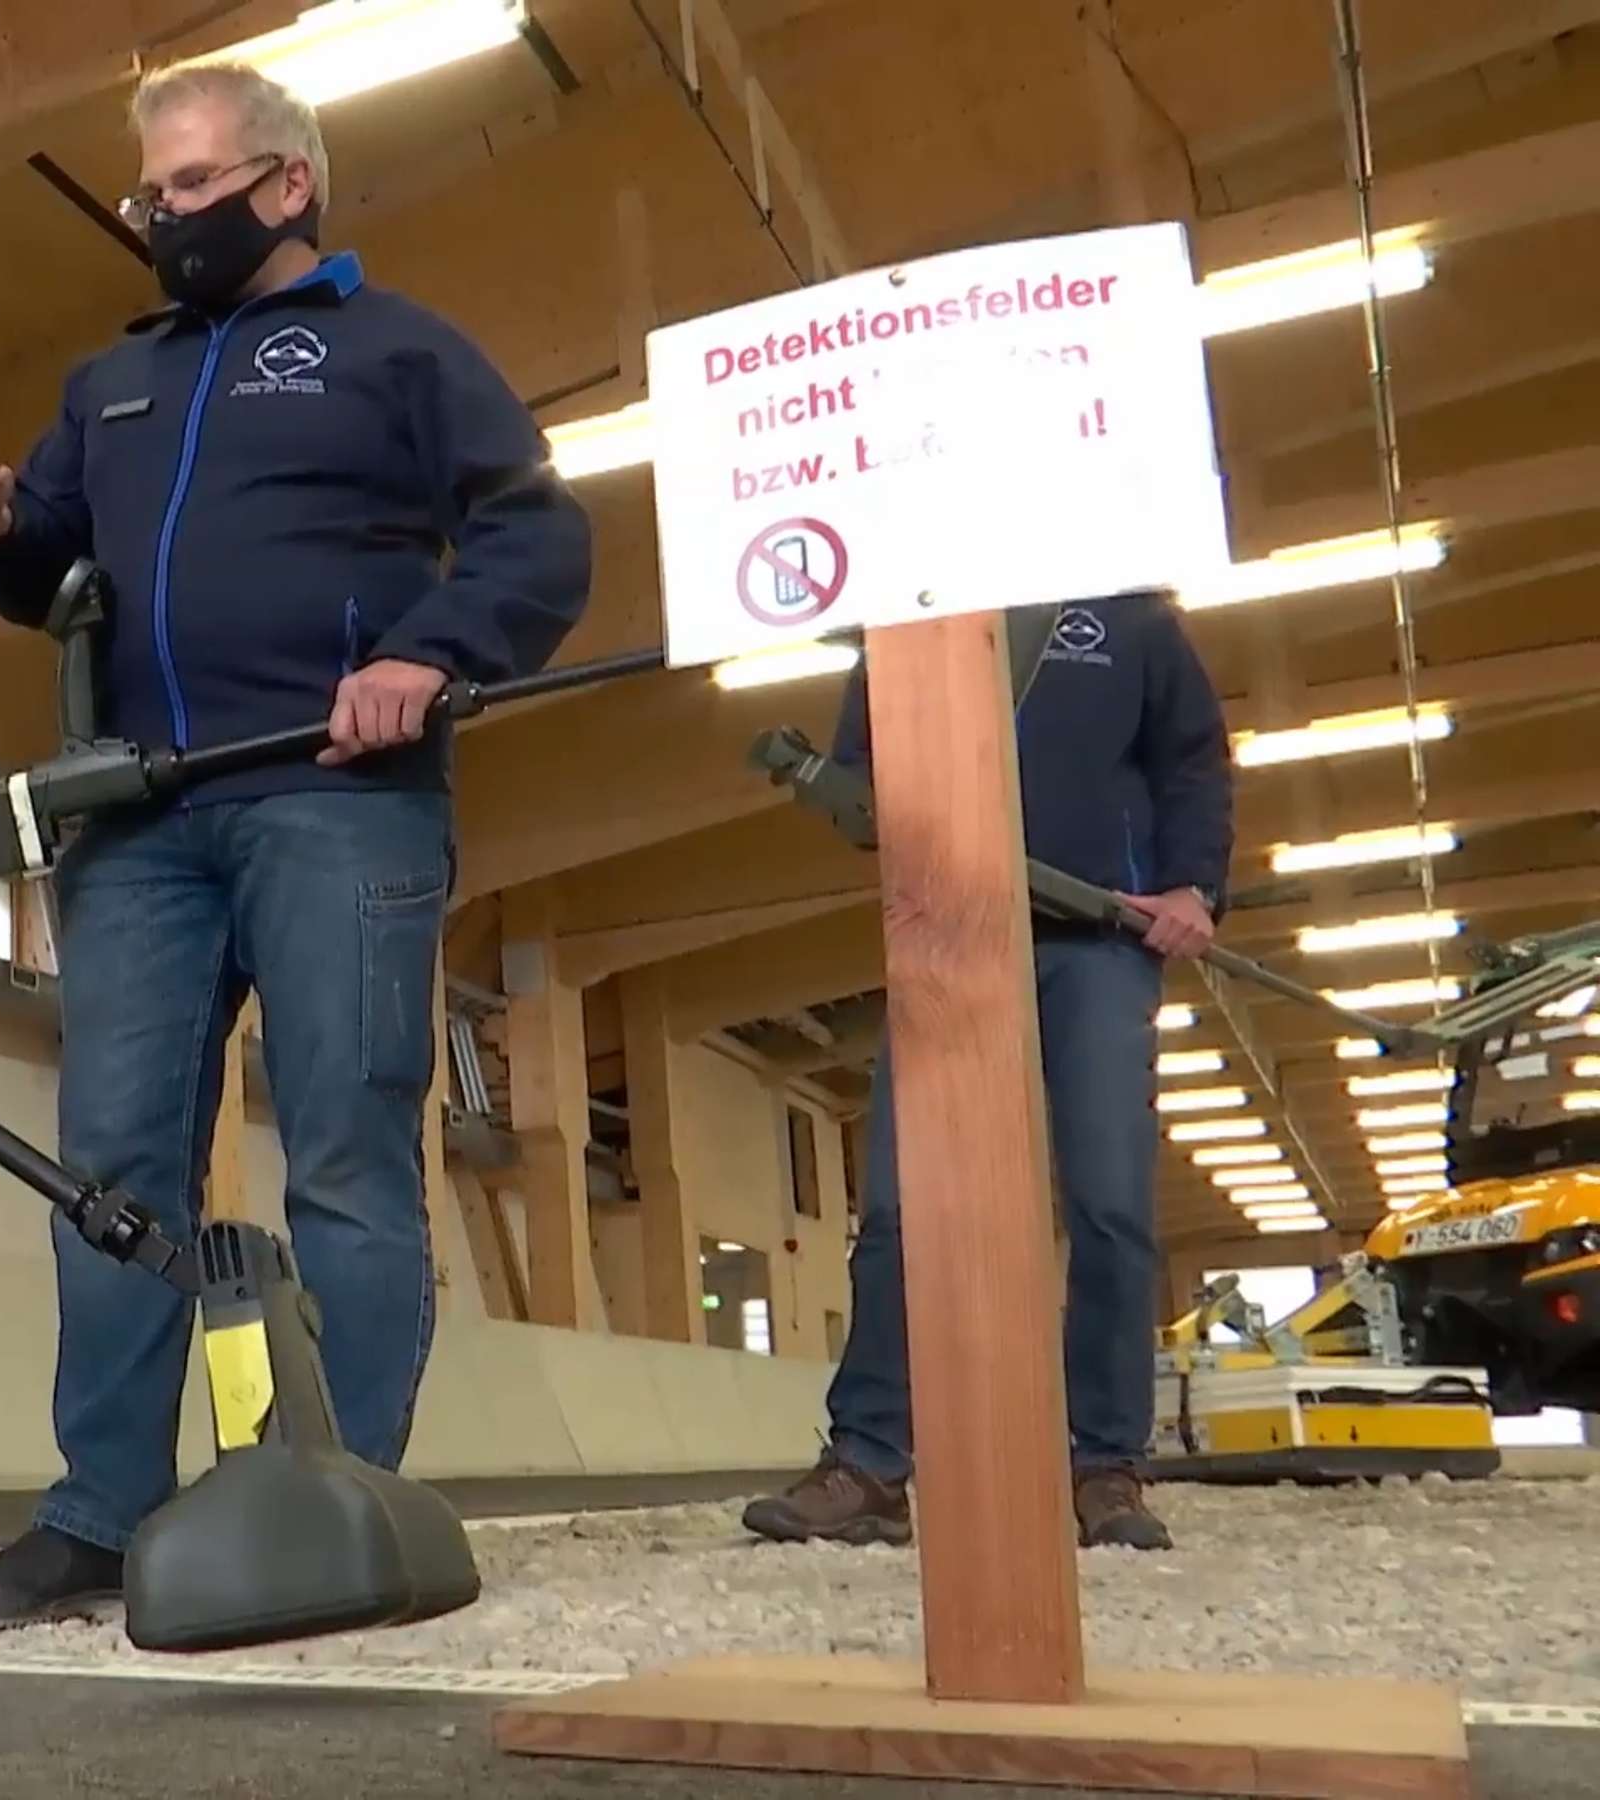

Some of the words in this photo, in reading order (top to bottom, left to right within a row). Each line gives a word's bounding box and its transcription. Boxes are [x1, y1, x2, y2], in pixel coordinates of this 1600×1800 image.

[703, 272, 1118, 386] Detektionsfelder
[737, 375, 857, 438] nicht
[733, 453, 838, 502] bzw.
